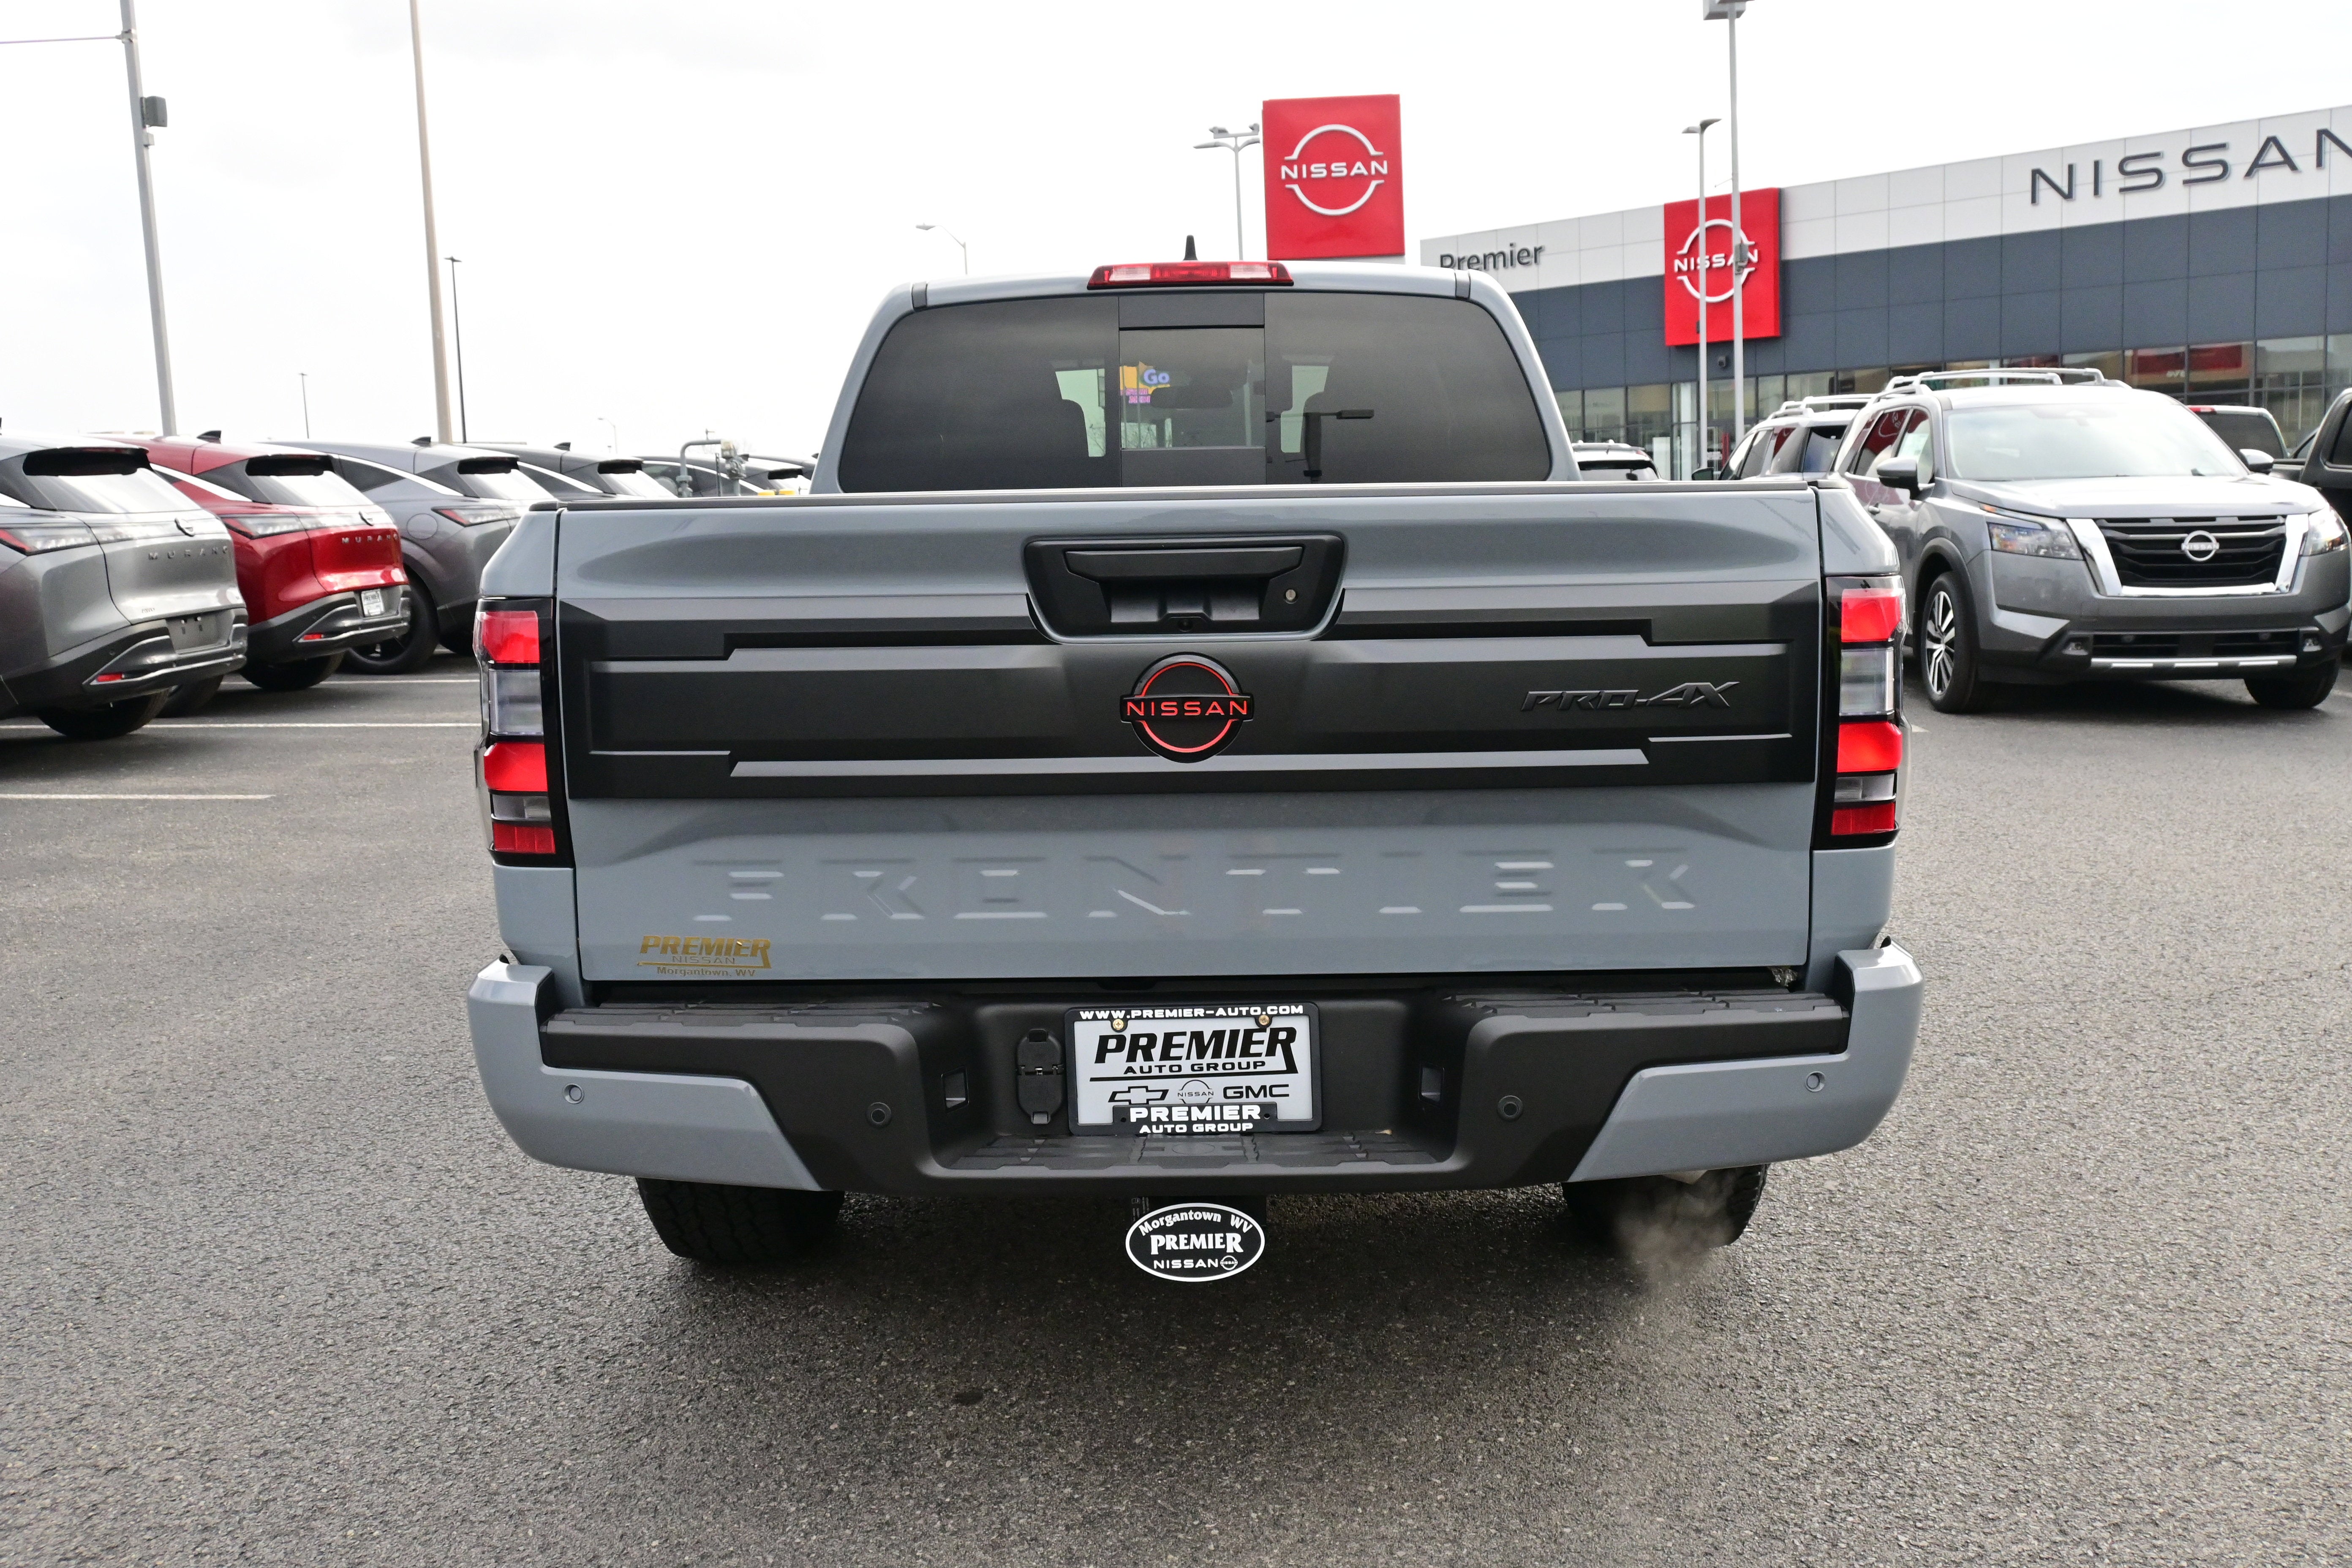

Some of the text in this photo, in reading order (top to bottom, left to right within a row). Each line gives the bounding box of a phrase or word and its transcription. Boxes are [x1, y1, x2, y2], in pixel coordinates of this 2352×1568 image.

[1281, 159, 1388, 180] NISSAN
[2031, 127, 2352, 205] NISSAN
[1440, 242, 1545, 270] Premier
[1143, 368, 1170, 385] Go
[341, 534, 399, 544] MURANO
[1520, 681, 1740, 711] PRO-4X
[1126, 700, 1248, 717] NISSAN
[692, 848, 1696, 922] FRONTIER
[640, 935, 772, 968] PREMIER
[672, 956, 735, 964] NISSAN
[735, 969, 756, 977] WV
[1080, 1005, 1304, 1020] WWW.PREMIER-AUTO.COM
[1094, 1026, 1298, 1074] PREMIER
[1123, 1061, 1266, 1075] AUTO GROUP
[1222, 1084, 1290, 1099] GMC
[1130, 1105, 1261, 1122] PREMIER
[1139, 1123, 1253, 1134] AUTO GROUP
[1138, 1209, 1222, 1236] Morgantown
[1230, 1214, 1253, 1233] WV
[1150, 1233, 1244, 1255] PREMIER
[1153, 1258, 1219, 1269] NISSAN
